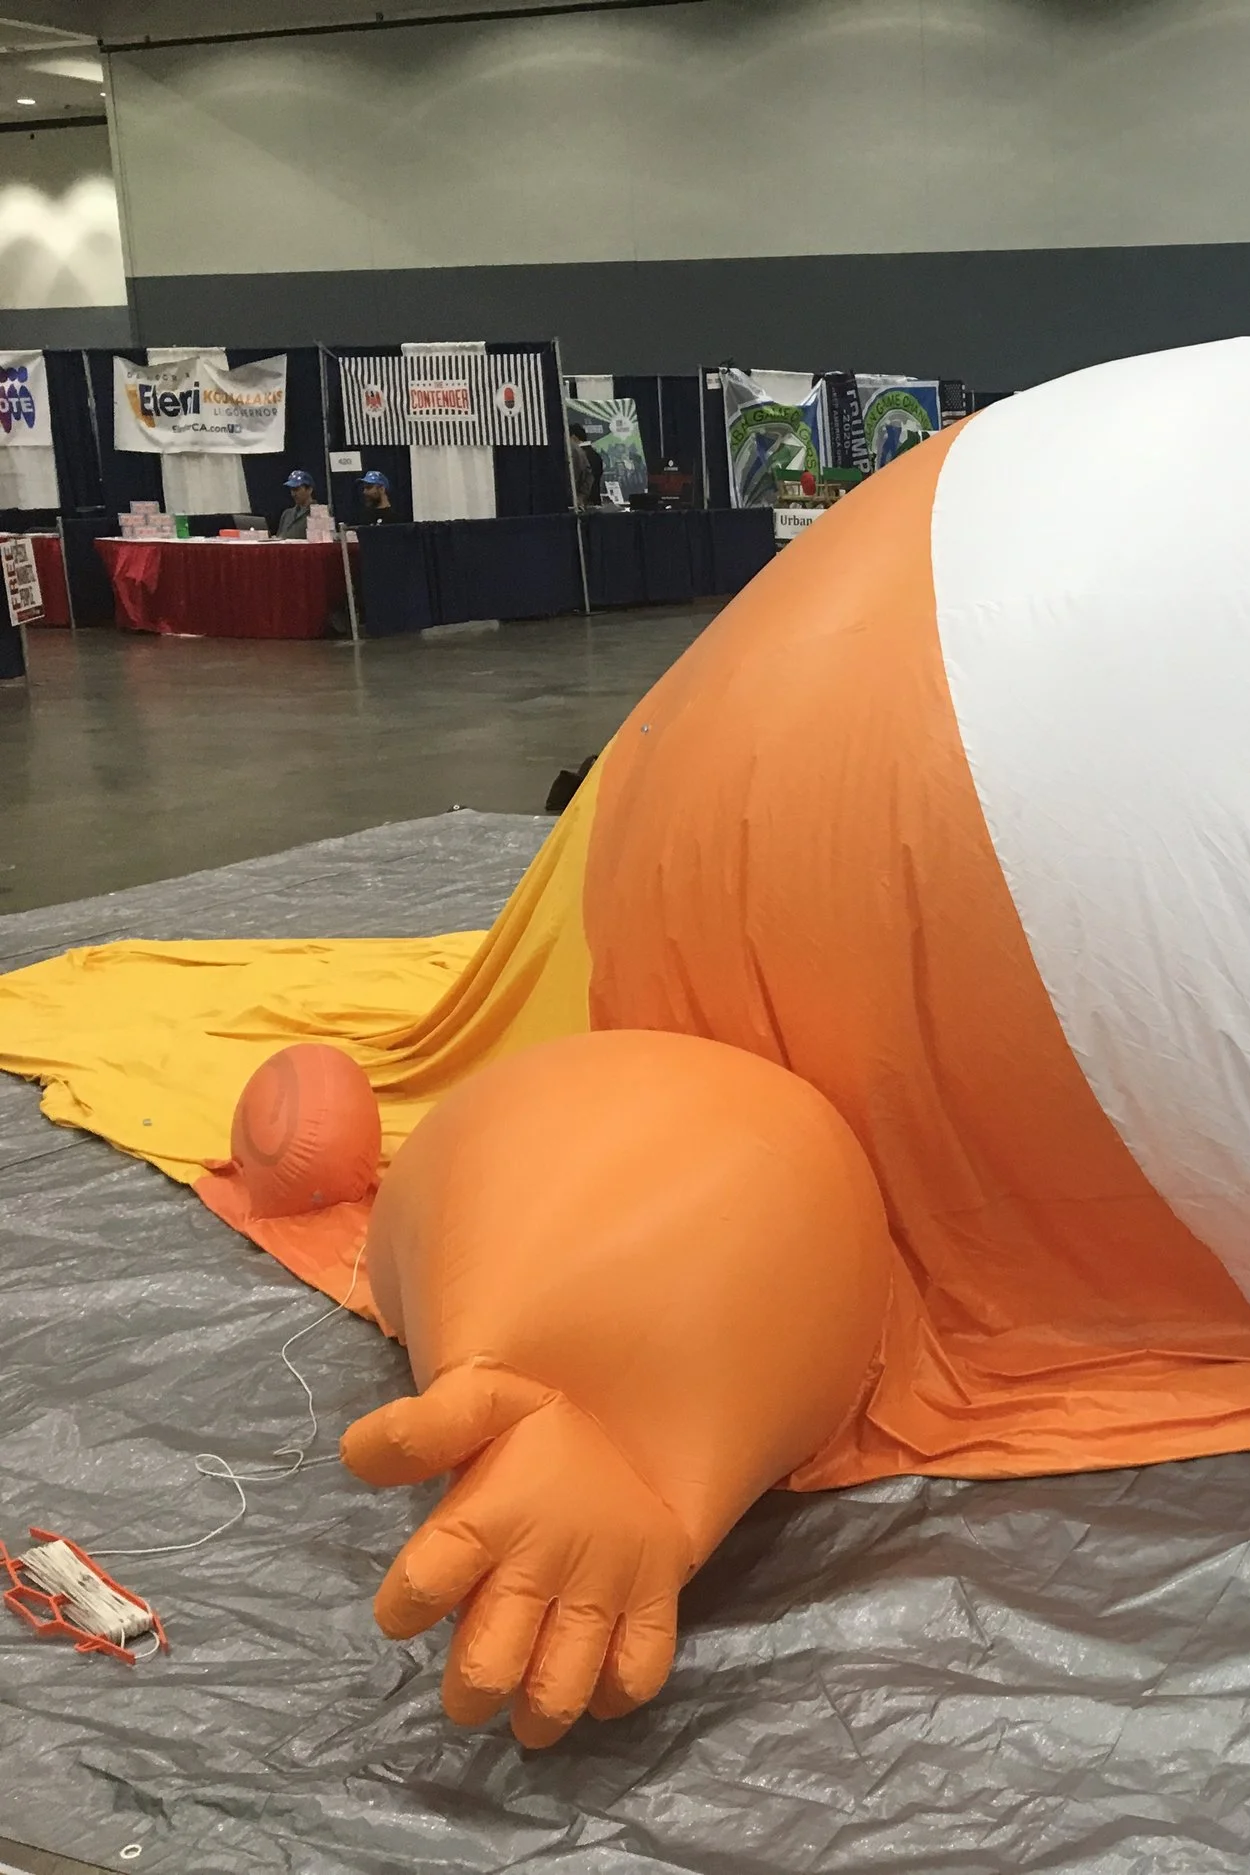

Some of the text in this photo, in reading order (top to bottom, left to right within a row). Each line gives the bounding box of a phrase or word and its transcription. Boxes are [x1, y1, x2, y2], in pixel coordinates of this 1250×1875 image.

[410, 388, 470, 410] CONTENDER
[226, 407, 278, 418] GOVERNOR
[846, 388, 872, 474] TRUMP
[780, 514, 813, 526] Urban
